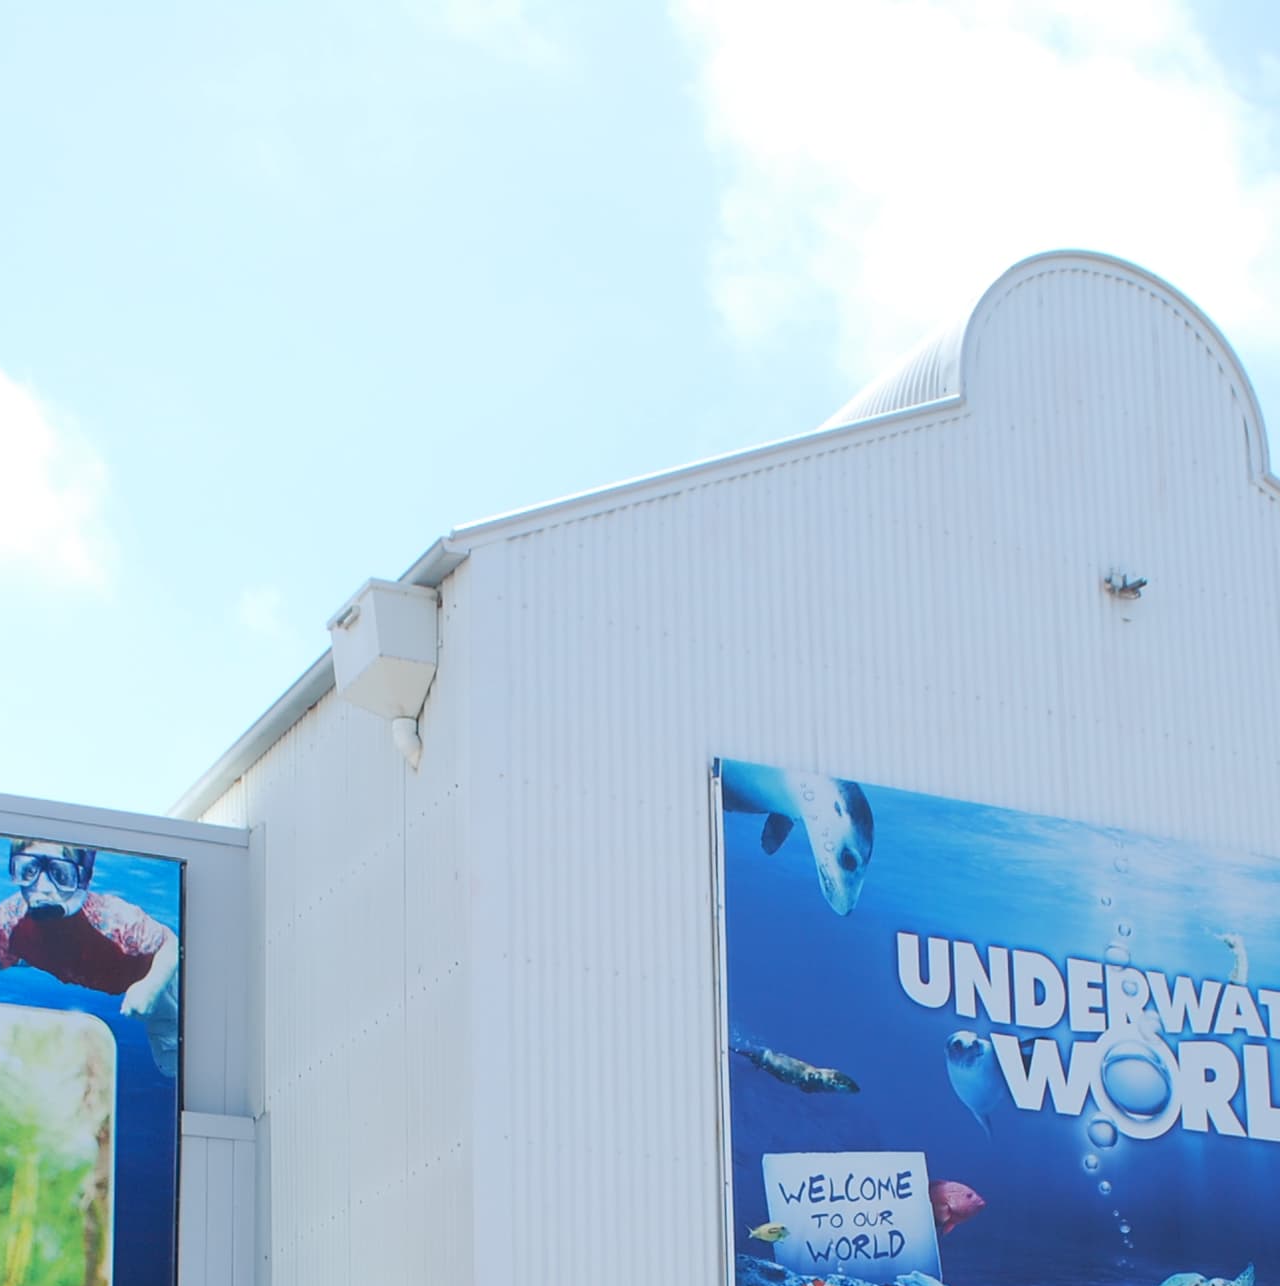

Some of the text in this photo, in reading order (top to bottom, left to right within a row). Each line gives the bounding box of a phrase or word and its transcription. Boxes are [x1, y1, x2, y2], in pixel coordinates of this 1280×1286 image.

[778, 1171, 913, 1204] WELCOME
[811, 1210, 894, 1228] TO OUR
[806, 1229, 906, 1263] WORLD
